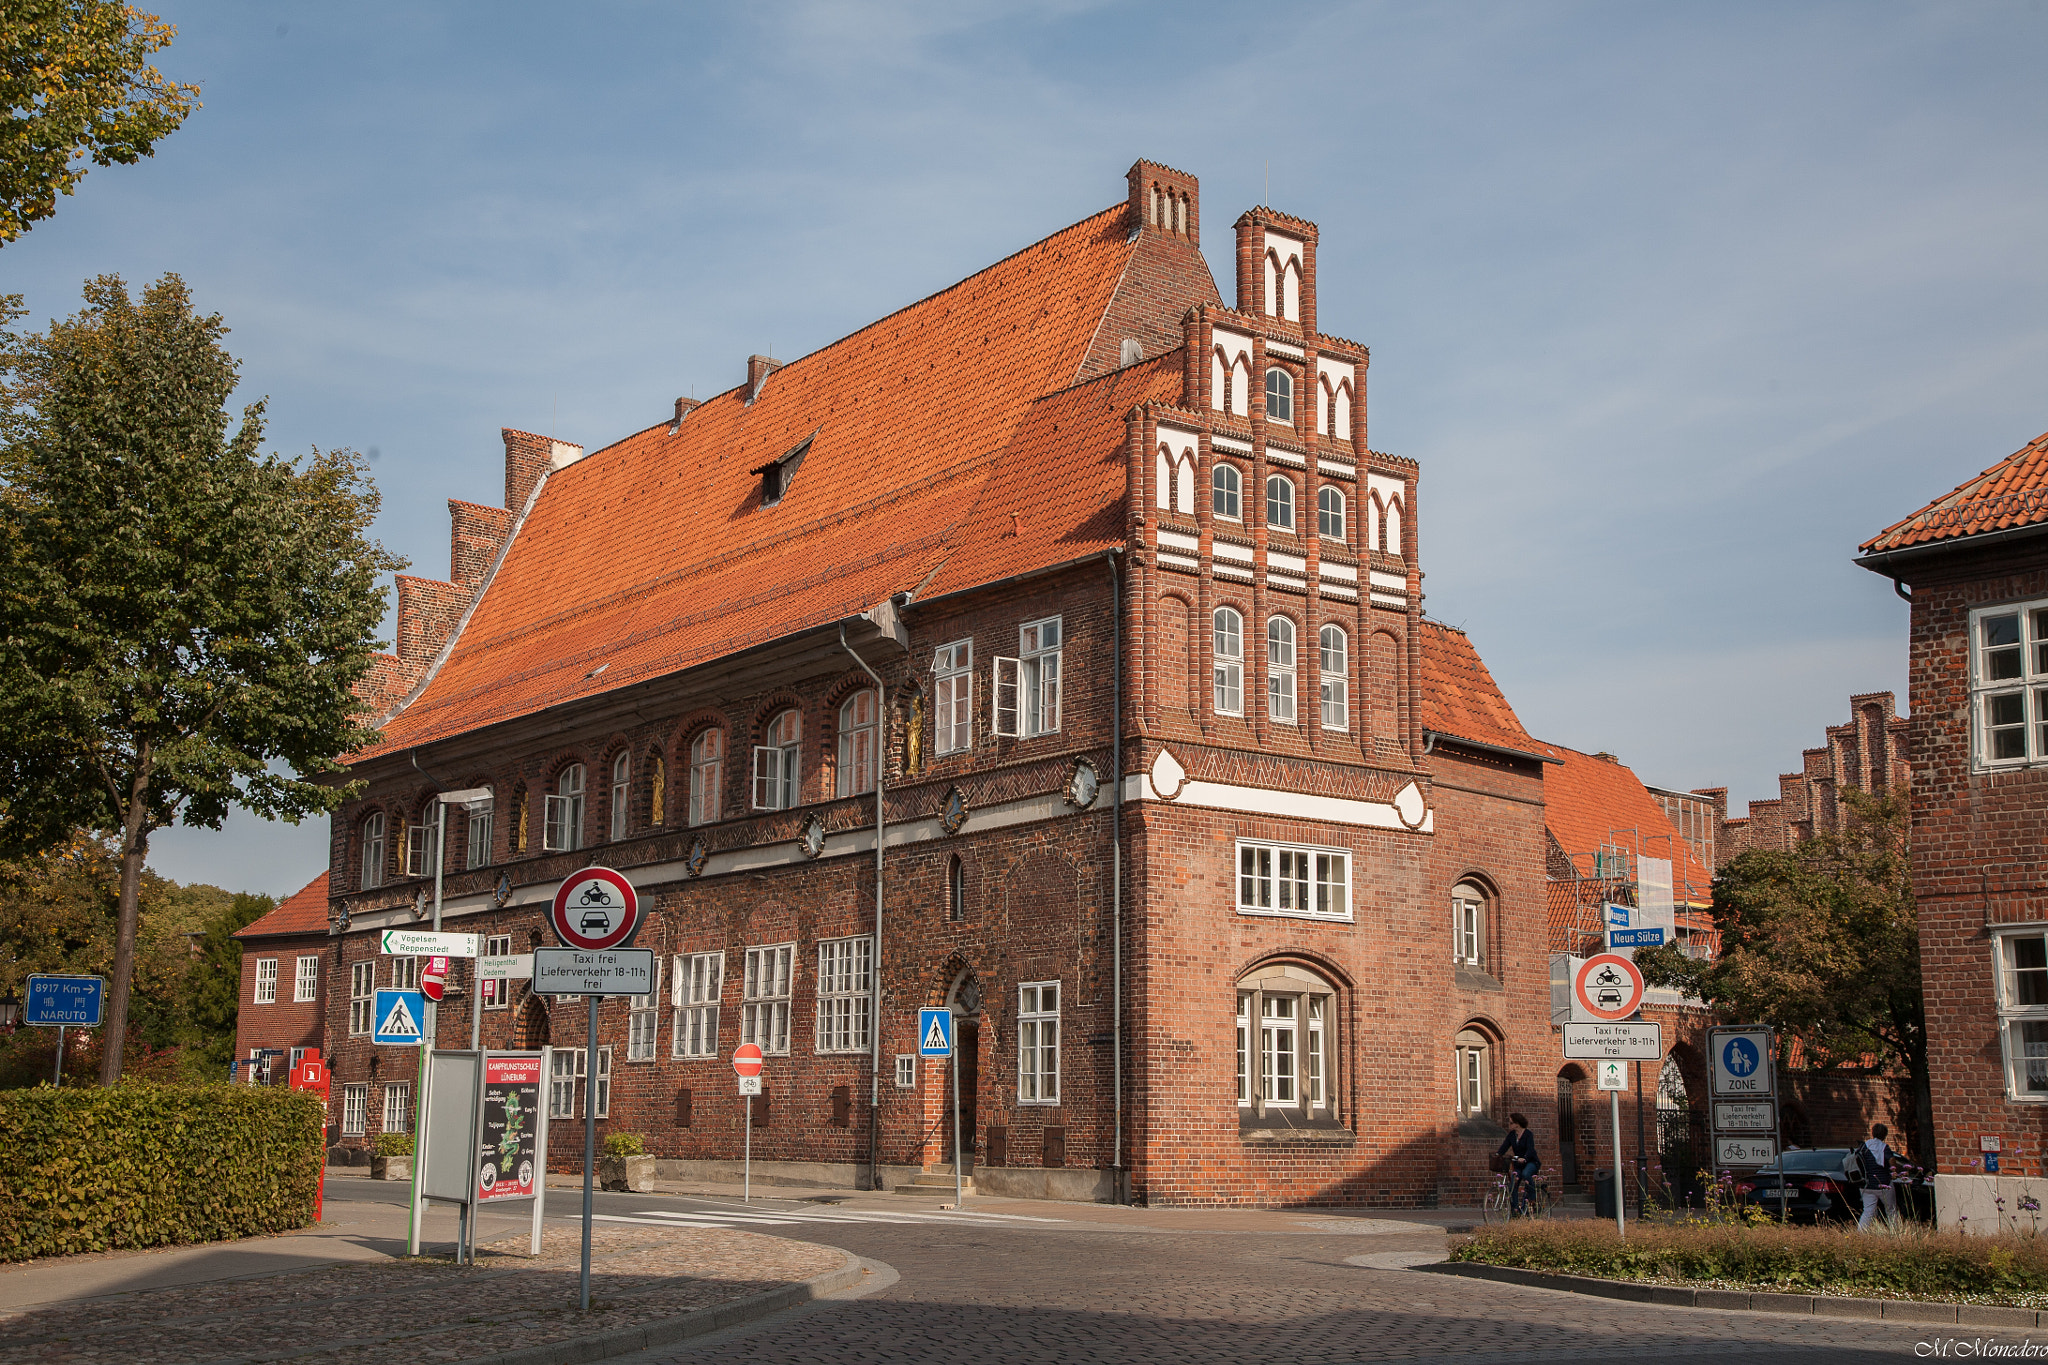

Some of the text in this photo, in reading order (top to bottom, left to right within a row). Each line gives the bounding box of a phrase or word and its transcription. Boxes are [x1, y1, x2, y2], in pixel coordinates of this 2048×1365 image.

[401, 934, 436, 943] Vögelsen
[1614, 931, 1660, 944] Neue Sülze
[400, 944, 449, 953] Reppenstedt
[484, 958, 518, 967] Heiligenthal
[573, 954, 617, 964] Taxi frei
[542, 966, 612, 976] Lieferverkehr
[584, 979, 602, 988] frei
[35, 984, 80, 993] 8917 Km
[40, 1010, 87, 1020] NARUTO
[1594, 1026, 1630, 1034] Taxi frei
[1570, 1036, 1626, 1046] Lieferverkehr
[488, 1062, 539, 1070] KAMPFKUNSTSCHULE
[501, 1072, 526, 1081] LÜNEBURG
[1728, 1080, 1756, 1090] ZONE
[1752, 1147, 1770, 1157] frei
